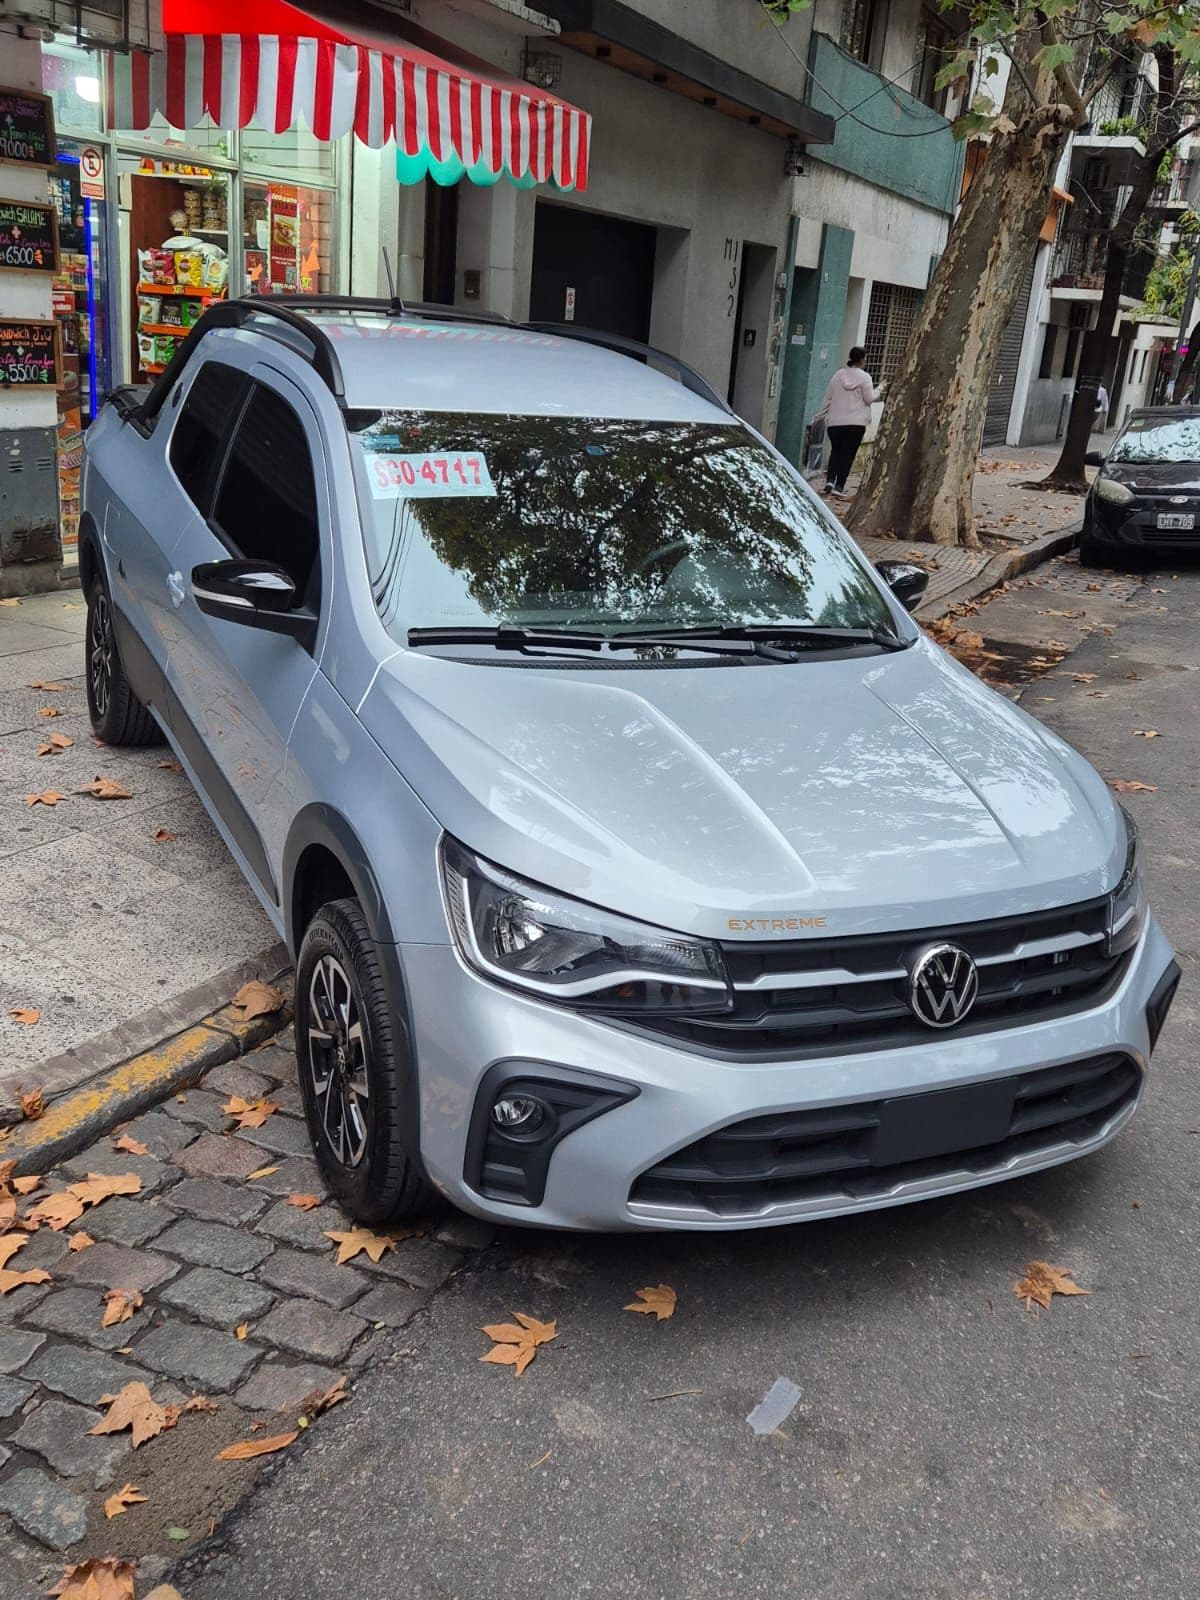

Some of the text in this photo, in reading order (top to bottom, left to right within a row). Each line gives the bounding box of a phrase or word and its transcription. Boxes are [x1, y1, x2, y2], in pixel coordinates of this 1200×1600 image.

[6, 245, 34, 265] 6500
[9, 363, 39, 382] 5500
[728, 915, 827, 931] EXTREME
